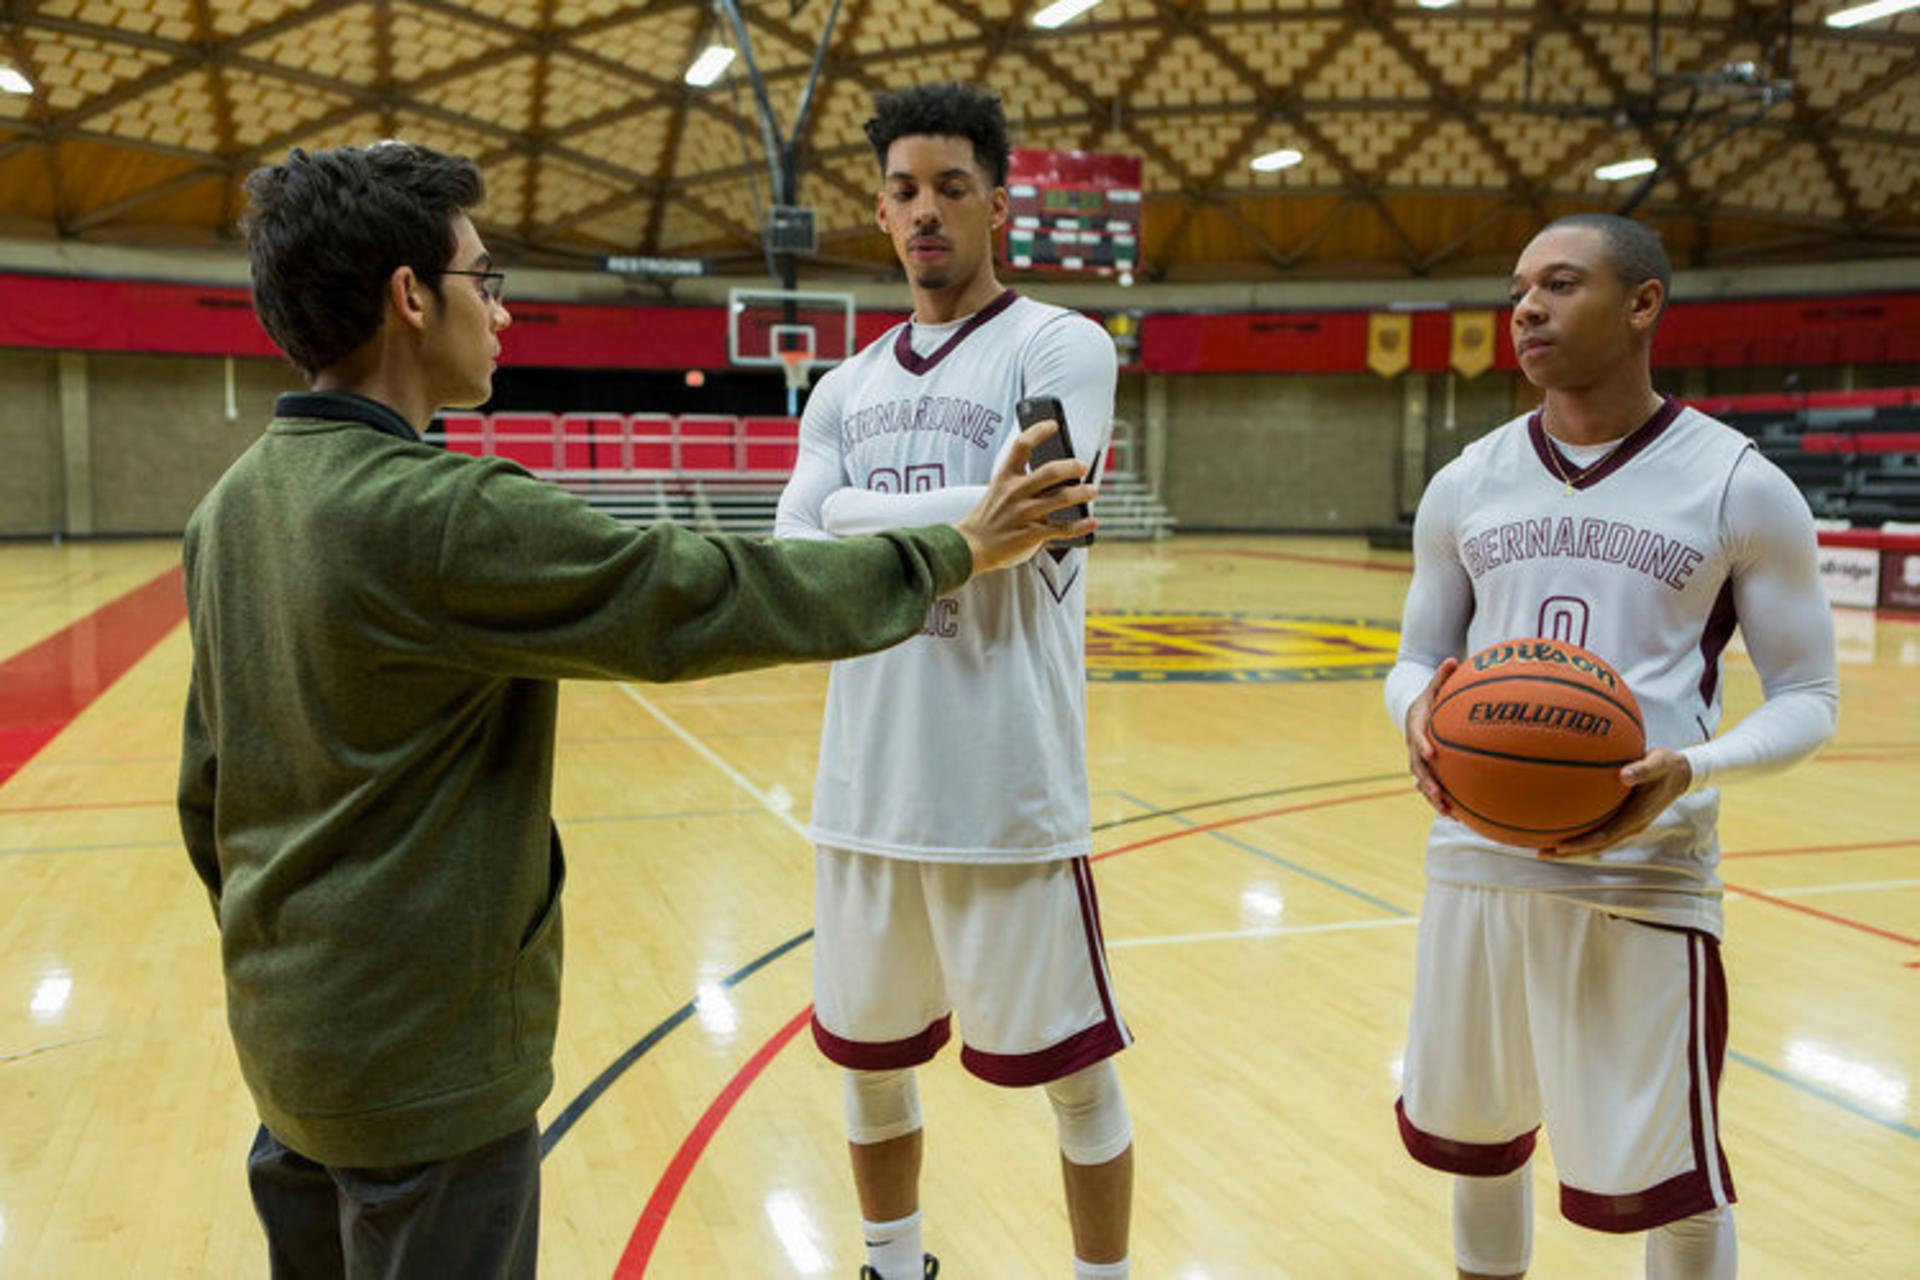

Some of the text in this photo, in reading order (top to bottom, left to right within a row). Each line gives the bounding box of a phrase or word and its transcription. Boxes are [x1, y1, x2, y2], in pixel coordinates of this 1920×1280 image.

[607, 257, 702, 274] RESTROOMS
[841, 396, 1002, 451] ERNARDINE
[1464, 516, 1703, 591] BERNARDINE
[1469, 702, 1612, 737] EVOLUTION
